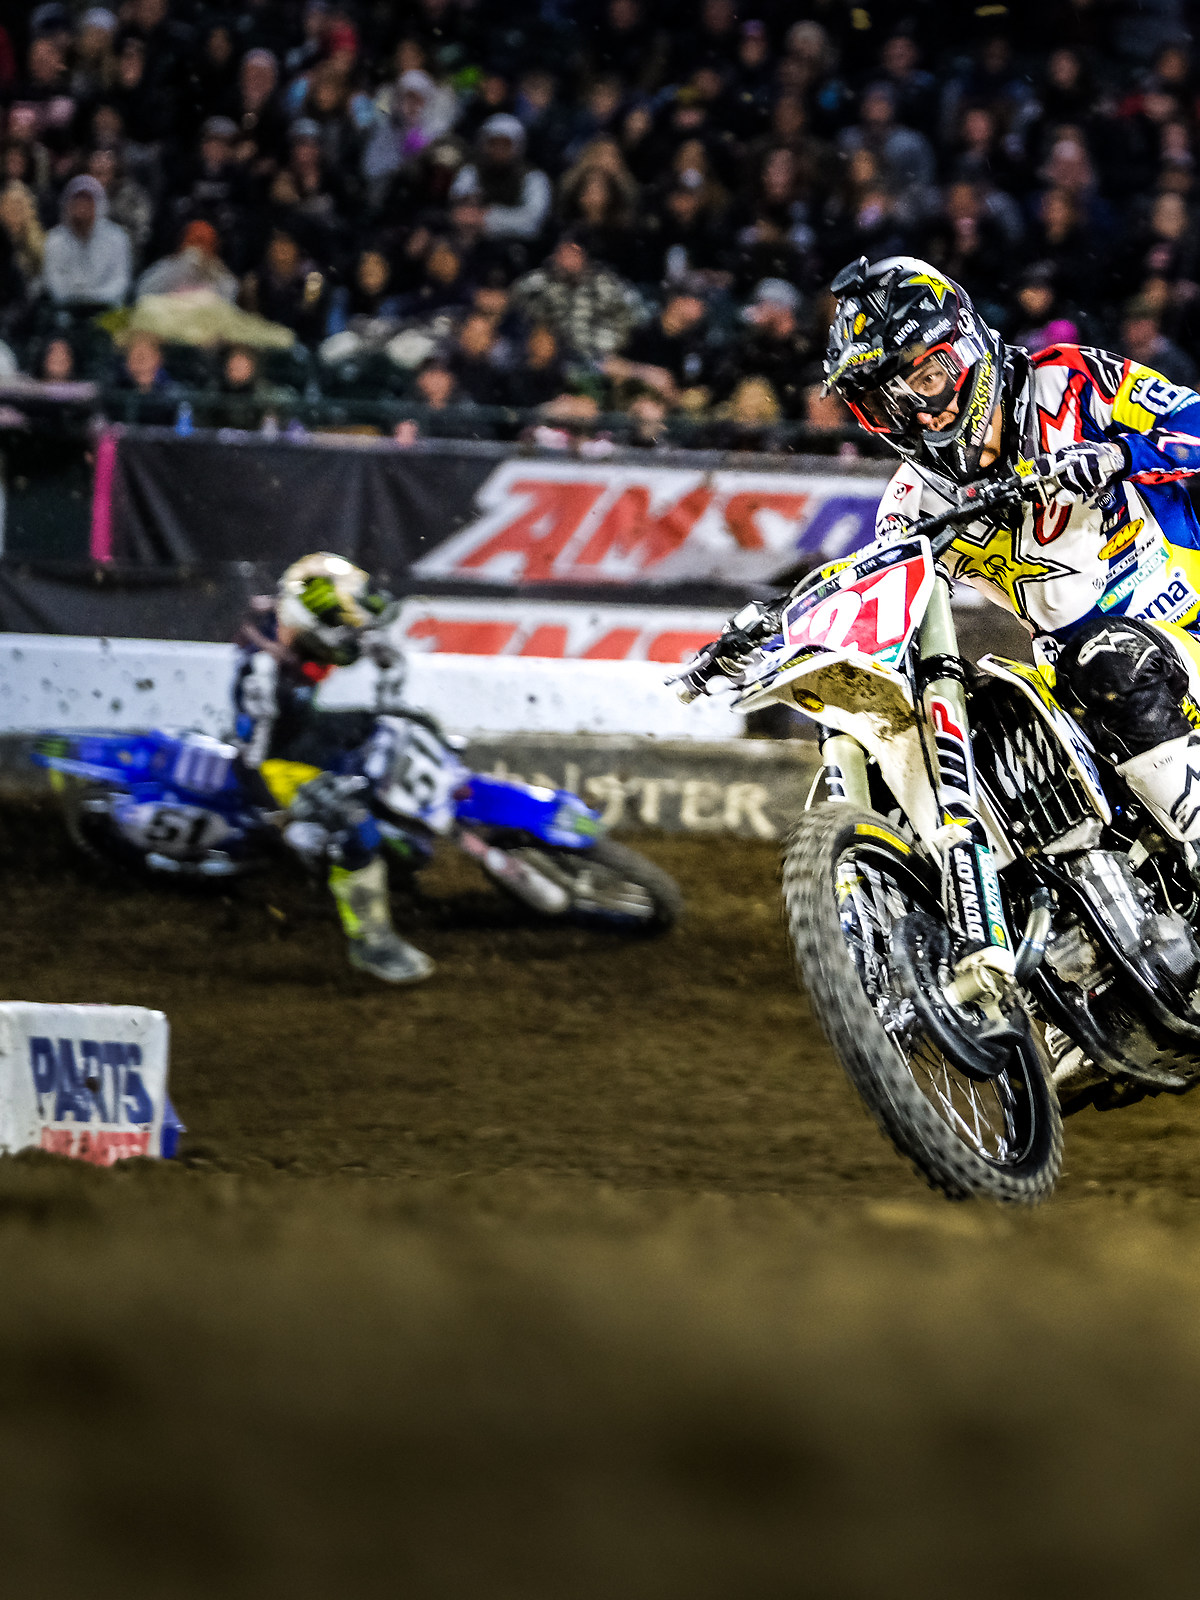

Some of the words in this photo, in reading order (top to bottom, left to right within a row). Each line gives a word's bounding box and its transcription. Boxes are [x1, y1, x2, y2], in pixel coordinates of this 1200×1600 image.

[1113, 550, 1167, 600] MOTOREX
[953, 847, 986, 942] DUNLOP
[29, 1035, 154, 1124] PARTS
